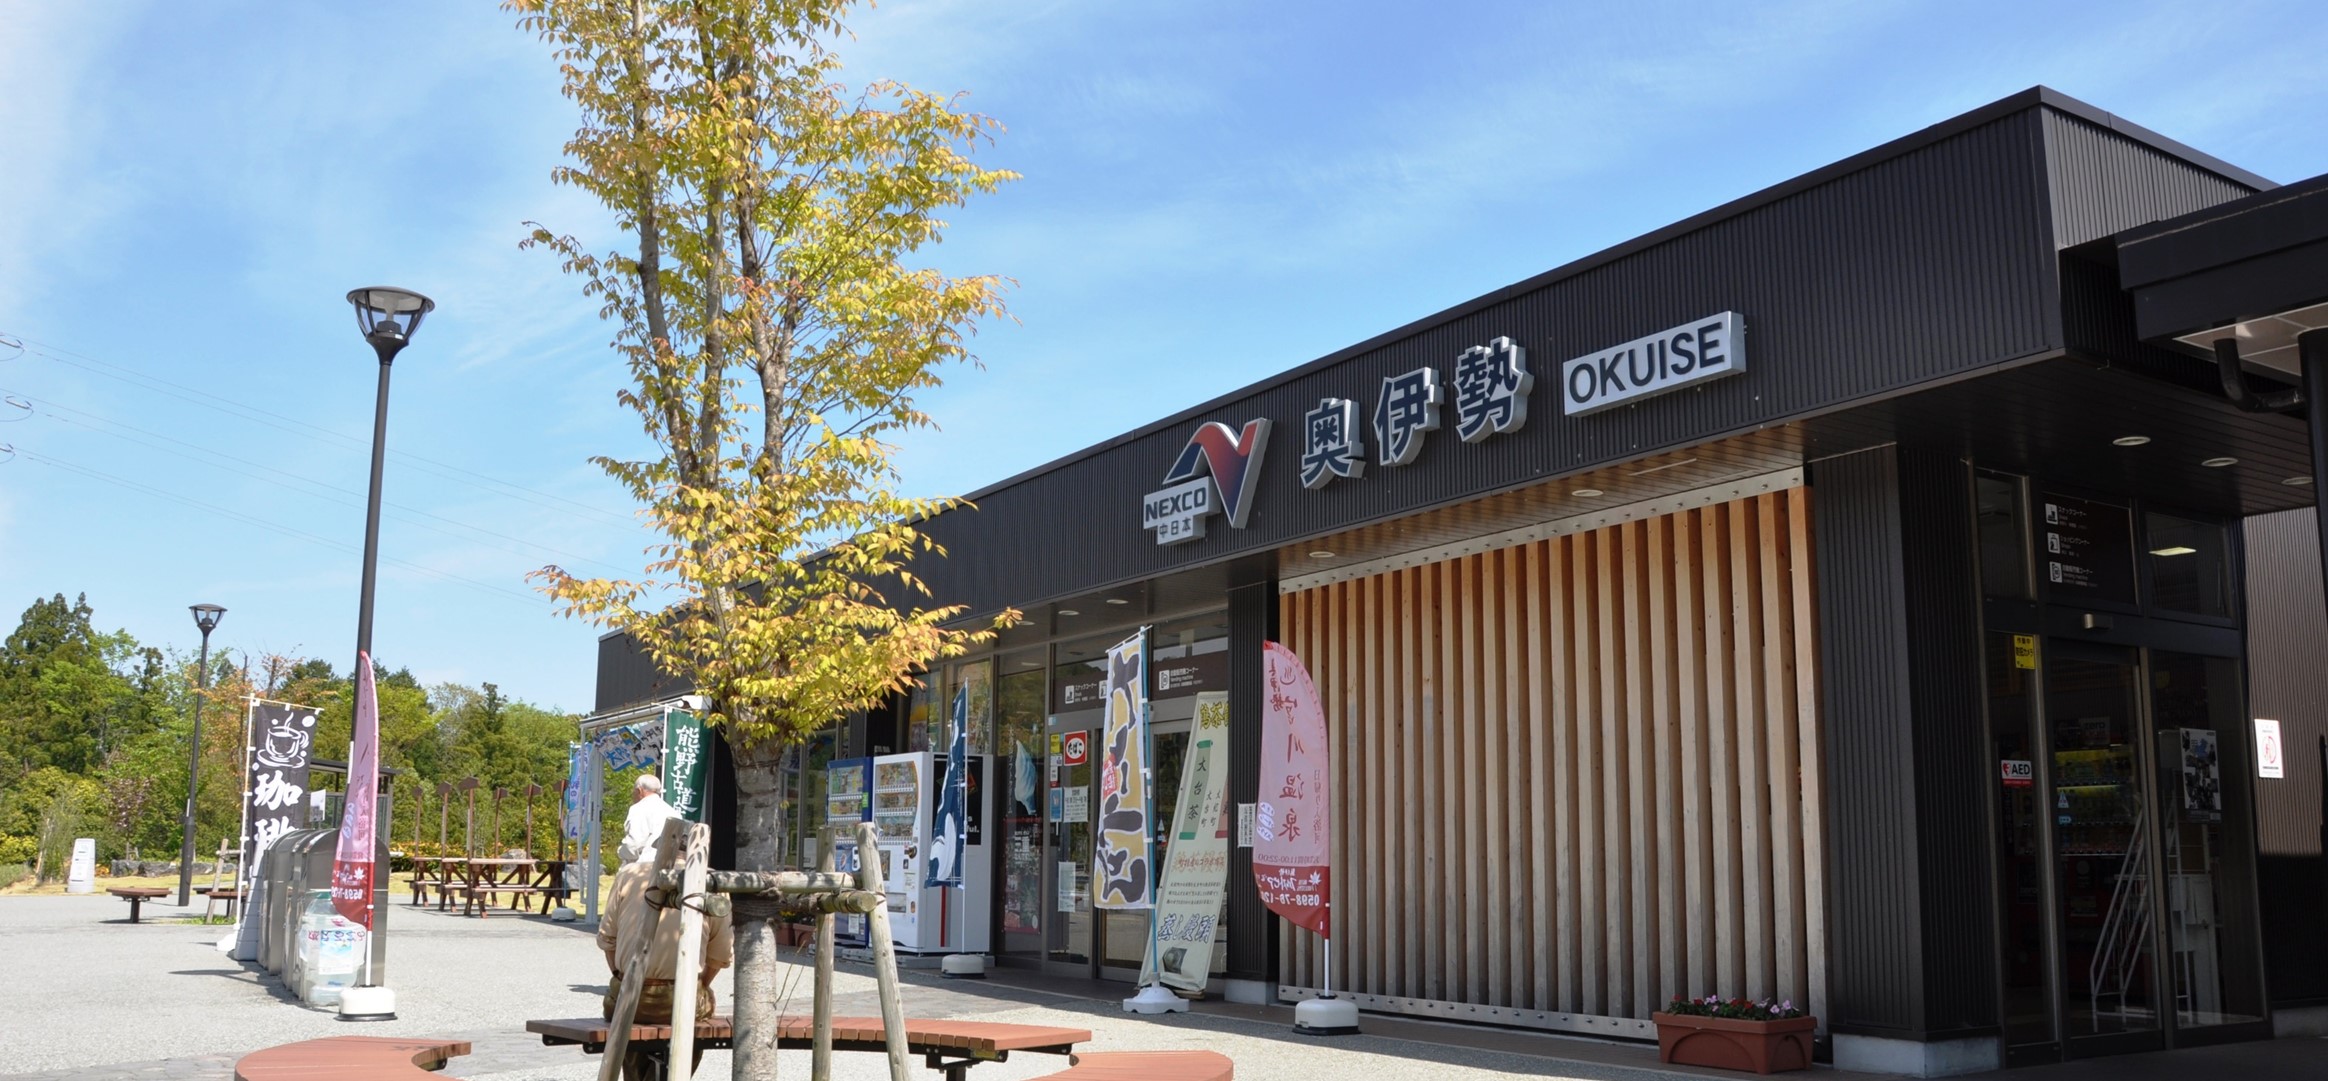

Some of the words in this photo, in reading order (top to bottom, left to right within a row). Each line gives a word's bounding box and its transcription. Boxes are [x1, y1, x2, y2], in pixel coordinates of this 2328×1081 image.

[1568, 322, 1725, 404] OKUISE
[1301, 337, 1525, 489] 奥伊勢
[1145, 487, 1207, 522] NEXCO
[1159, 516, 1191, 538] 中日本
[1067, 742, 1083, 756] たばこ
[2011, 763, 2031, 775] AED
[1187, 758, 1207, 820] 大台茶
